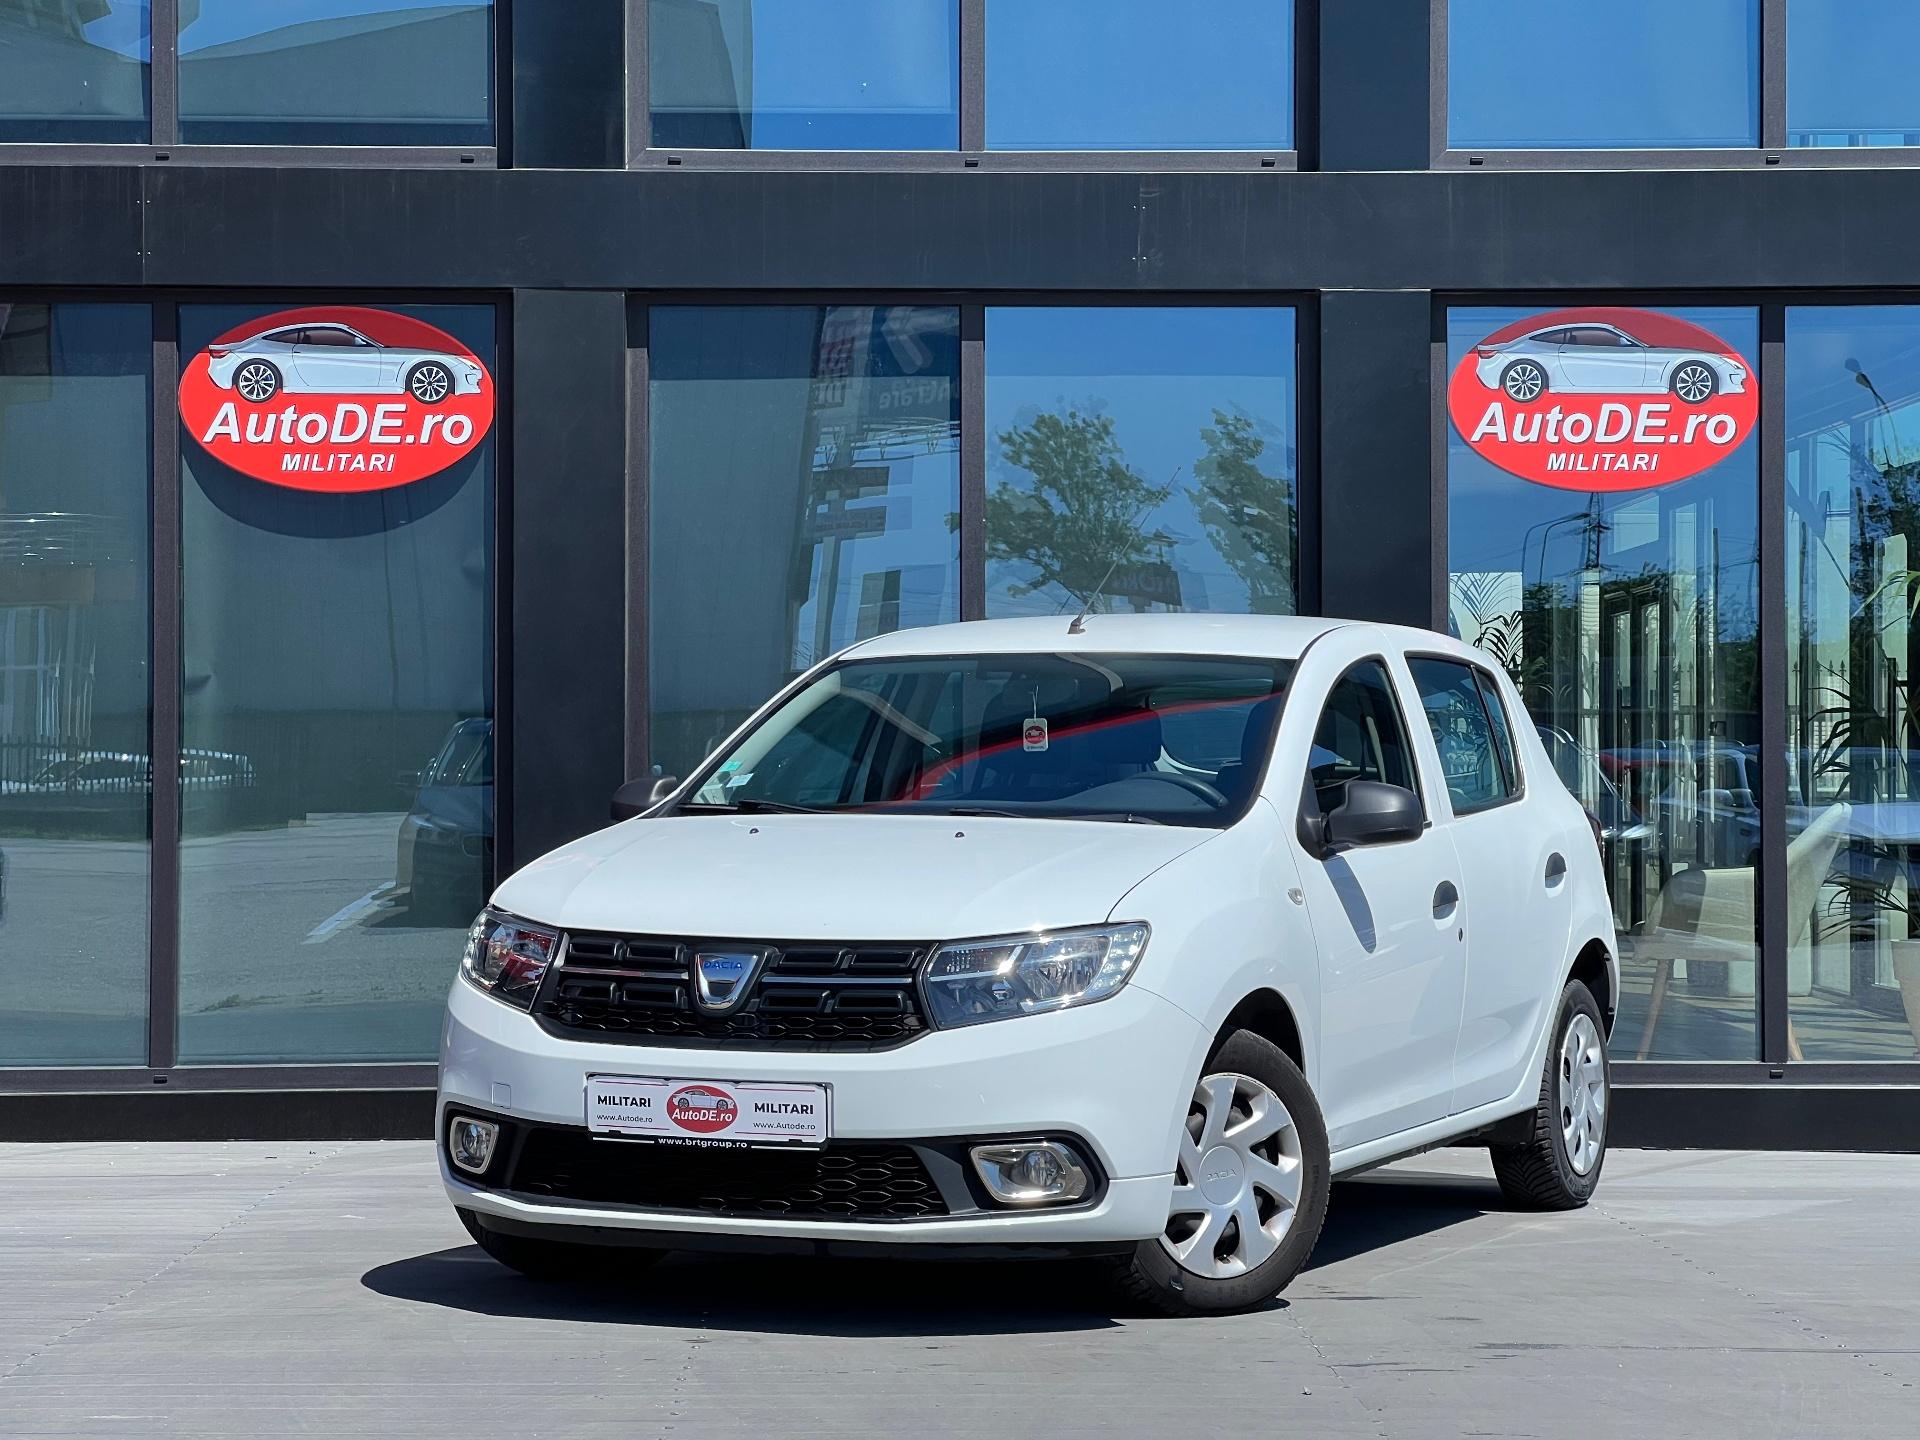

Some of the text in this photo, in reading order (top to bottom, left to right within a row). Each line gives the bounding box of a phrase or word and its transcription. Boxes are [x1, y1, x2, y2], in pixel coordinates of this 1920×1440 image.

[203, 402, 473, 444] AutoDE.ro
[1471, 402, 1737, 444] AutoDE.ro
[281, 453, 395, 472] MILITARI
[1547, 453, 1658, 472] MILITARI
[703, 960, 743, 970] DACIA
[597, 1094, 651, 1108] MILITARI
[672, 1108, 733, 1123] AutoDE.ro
[754, 1102, 814, 1115] MILITARI
[596, 1113, 653, 1124] www.Autode.ro
[753, 1121, 816, 1131] www.Autode.ro
[658, 1137, 748, 1149] www.brtgroup.ro
